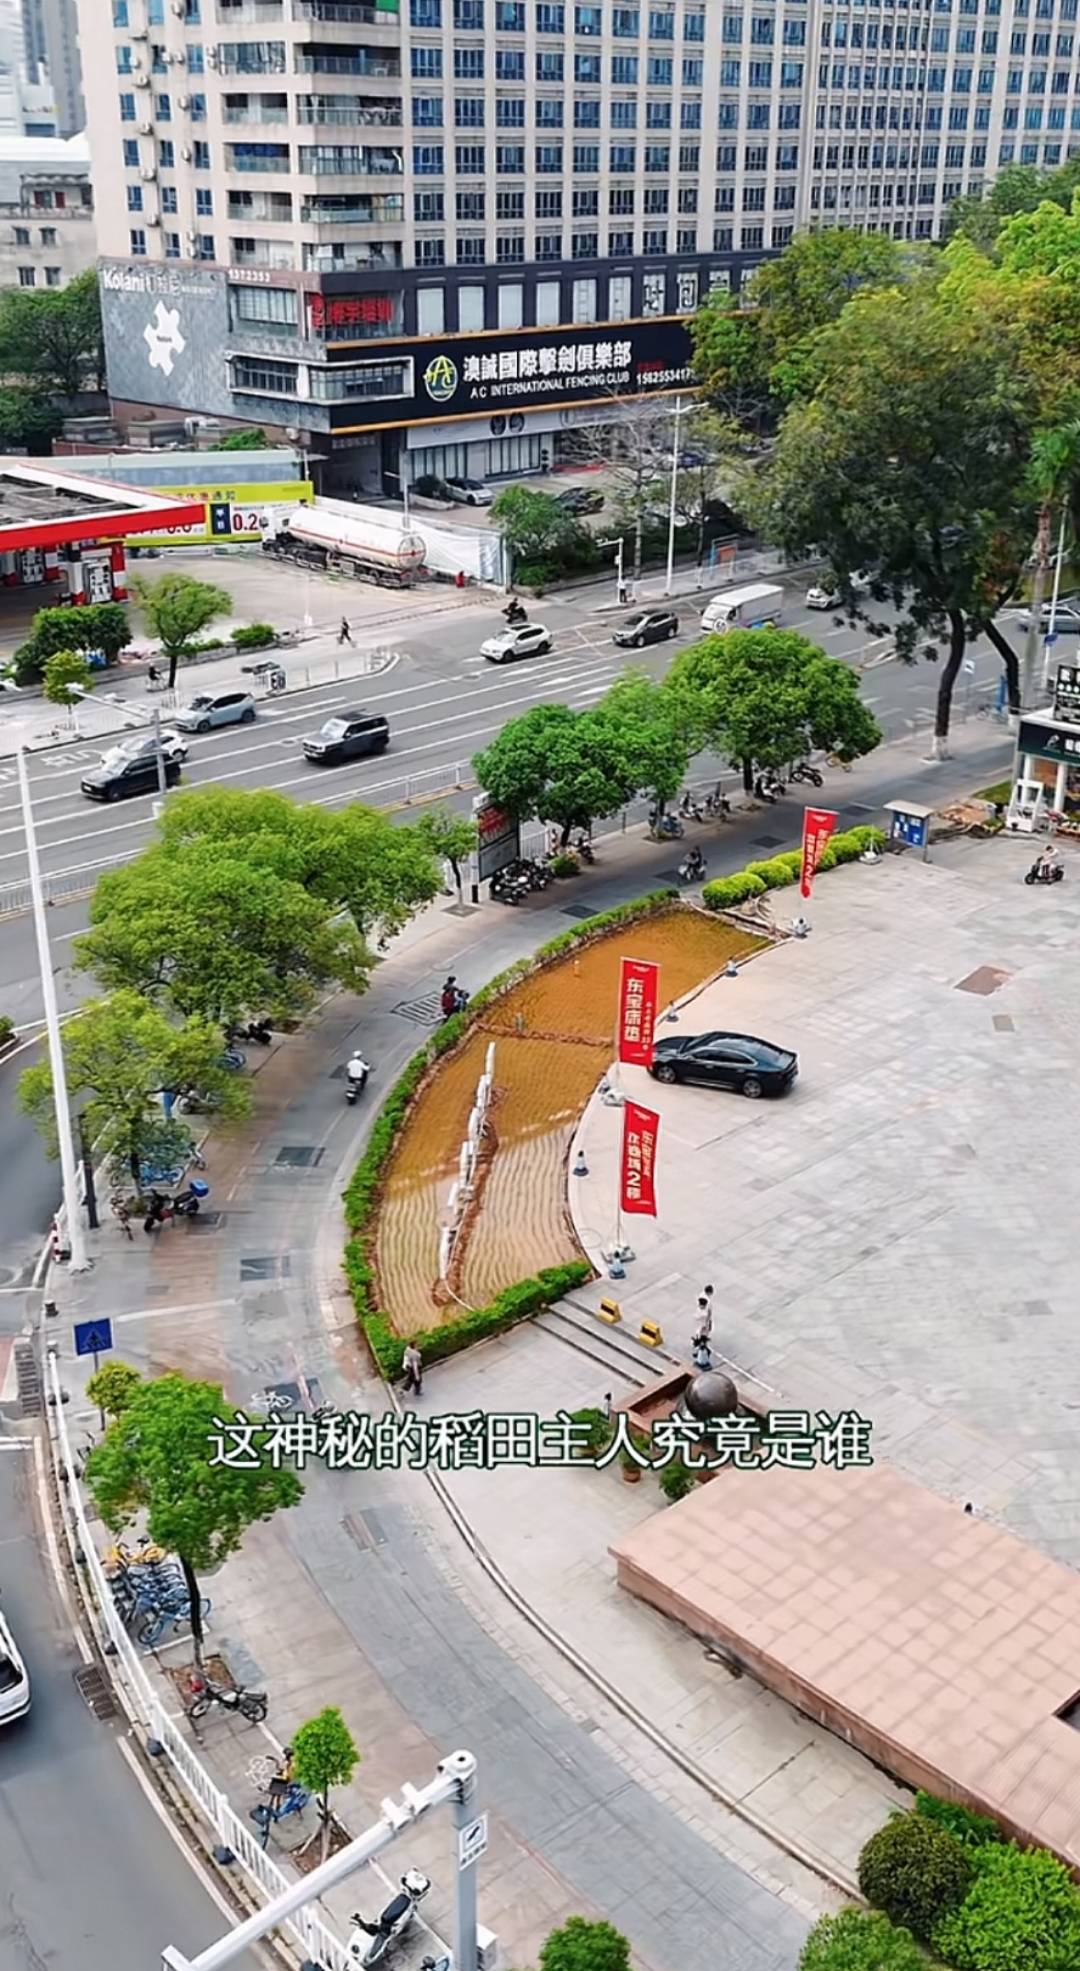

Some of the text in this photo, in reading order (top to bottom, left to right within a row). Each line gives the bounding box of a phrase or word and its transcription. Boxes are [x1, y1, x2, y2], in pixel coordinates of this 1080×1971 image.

[103, 269, 146, 293] Kolani
[490, 377, 563, 397] INTERNATIONAL
[565, 372, 605, 388] FENCING
[606, 370, 630, 384] CLUB
